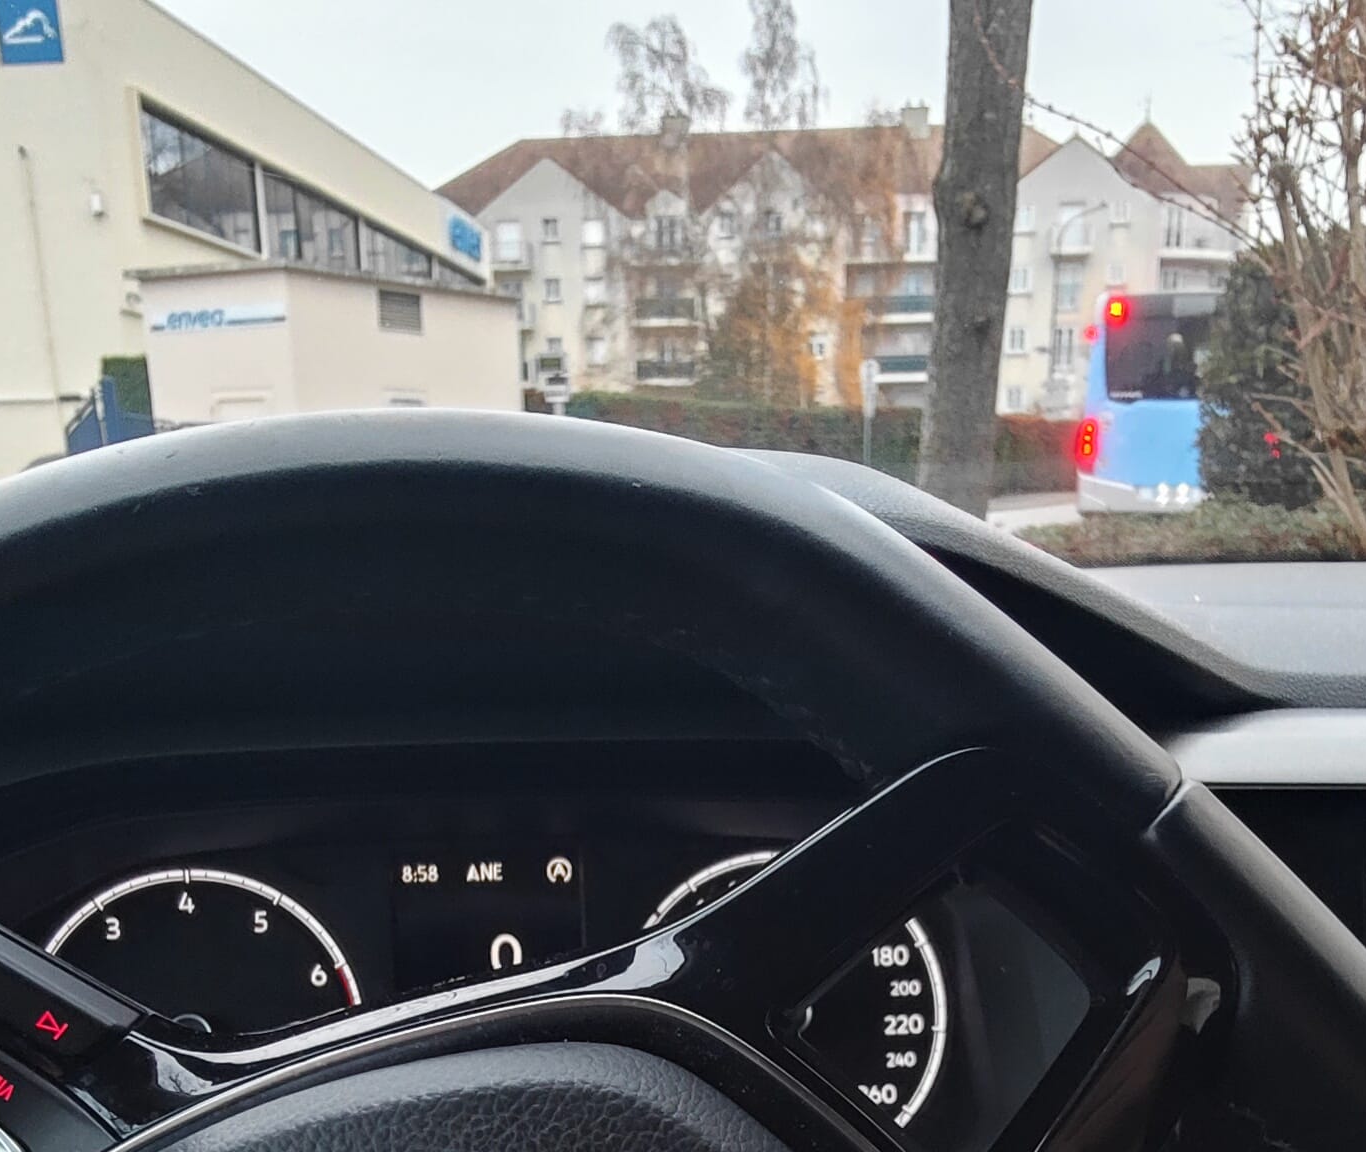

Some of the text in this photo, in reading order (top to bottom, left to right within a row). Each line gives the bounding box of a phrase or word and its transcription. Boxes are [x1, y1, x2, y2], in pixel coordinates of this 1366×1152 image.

[401, 864, 439, 883] 8:58
[466, 862, 503, 882] ANE
[178, 891, 196, 914] 4
[105, 916, 121, 940] 3
[253, 910, 269, 934] 5
[871, 944, 910, 967] 180
[310, 963, 328, 987] 6
[890, 979, 922, 997] 200
[883, 1013, 925, 1036] 220
[885, 1050, 917, 1069] 240
